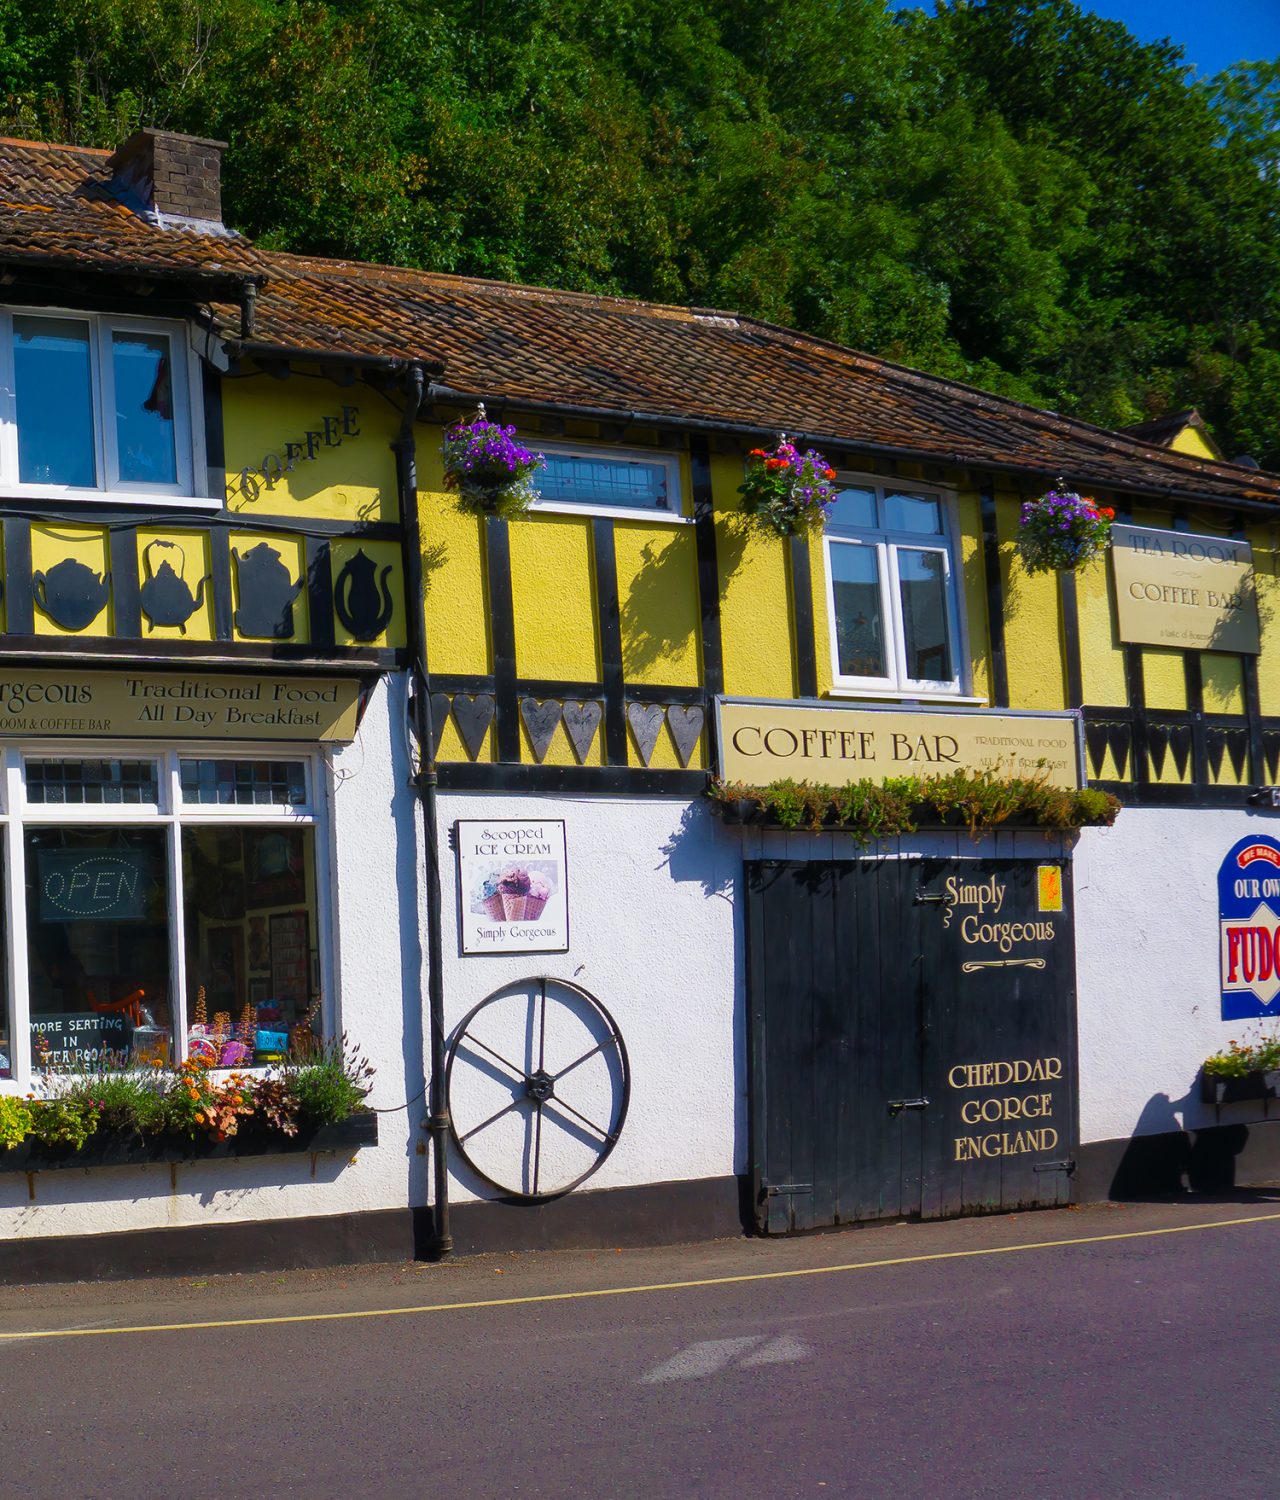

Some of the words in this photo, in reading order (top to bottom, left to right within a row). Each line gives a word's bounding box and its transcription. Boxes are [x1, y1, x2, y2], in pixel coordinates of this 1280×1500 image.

[1128, 534, 1165, 557] TEA
[1172, 540, 1239, 567] ROOM
[1129, 582, 1200, 606] COFFEE
[1207, 590, 1243, 611] BAR
[126, 679, 261, 701] Traditional
[272, 684, 338, 703] Food
[29, 718, 38, 730] &
[40, 718, 86, 730] COFFEE
[88, 719, 111, 731] BAR
[137, 704, 165, 722] All
[174, 705, 217, 728] Day
[225, 706, 322, 725] Breakfast
[732, 726, 876, 761] COFFEE
[890, 733, 961, 763] BAR
[975, 735, 1035, 748] TRADITIONAL
[1037, 739, 1067, 749] FOOD
[480, 828, 544, 843] Scooped
[475, 844, 498, 855] ICE
[504, 844, 551, 855] CREAM
[1243, 849, 1255, 862] WE
[1256, 847, 1279, 863] MAKE
[44, 871, 139, 900] OPEN
[1234, 879, 1260, 899] OUR
[944, 874, 1007, 928] Simply
[476, 926, 507, 943] Simply
[510, 926, 557, 941] Gorgeous
[961, 915, 1056, 953] Gorgeous
[30, 1020, 62, 1033] MORE
[63, 1035, 78, 1047] IN
[40, 1050, 71, 1064] TEA
[948, 1057, 1063, 1089] CHEDDAR
[961, 1093, 1052, 1124] GORGE
[953, 1127, 1059, 1161] ENGLAND
